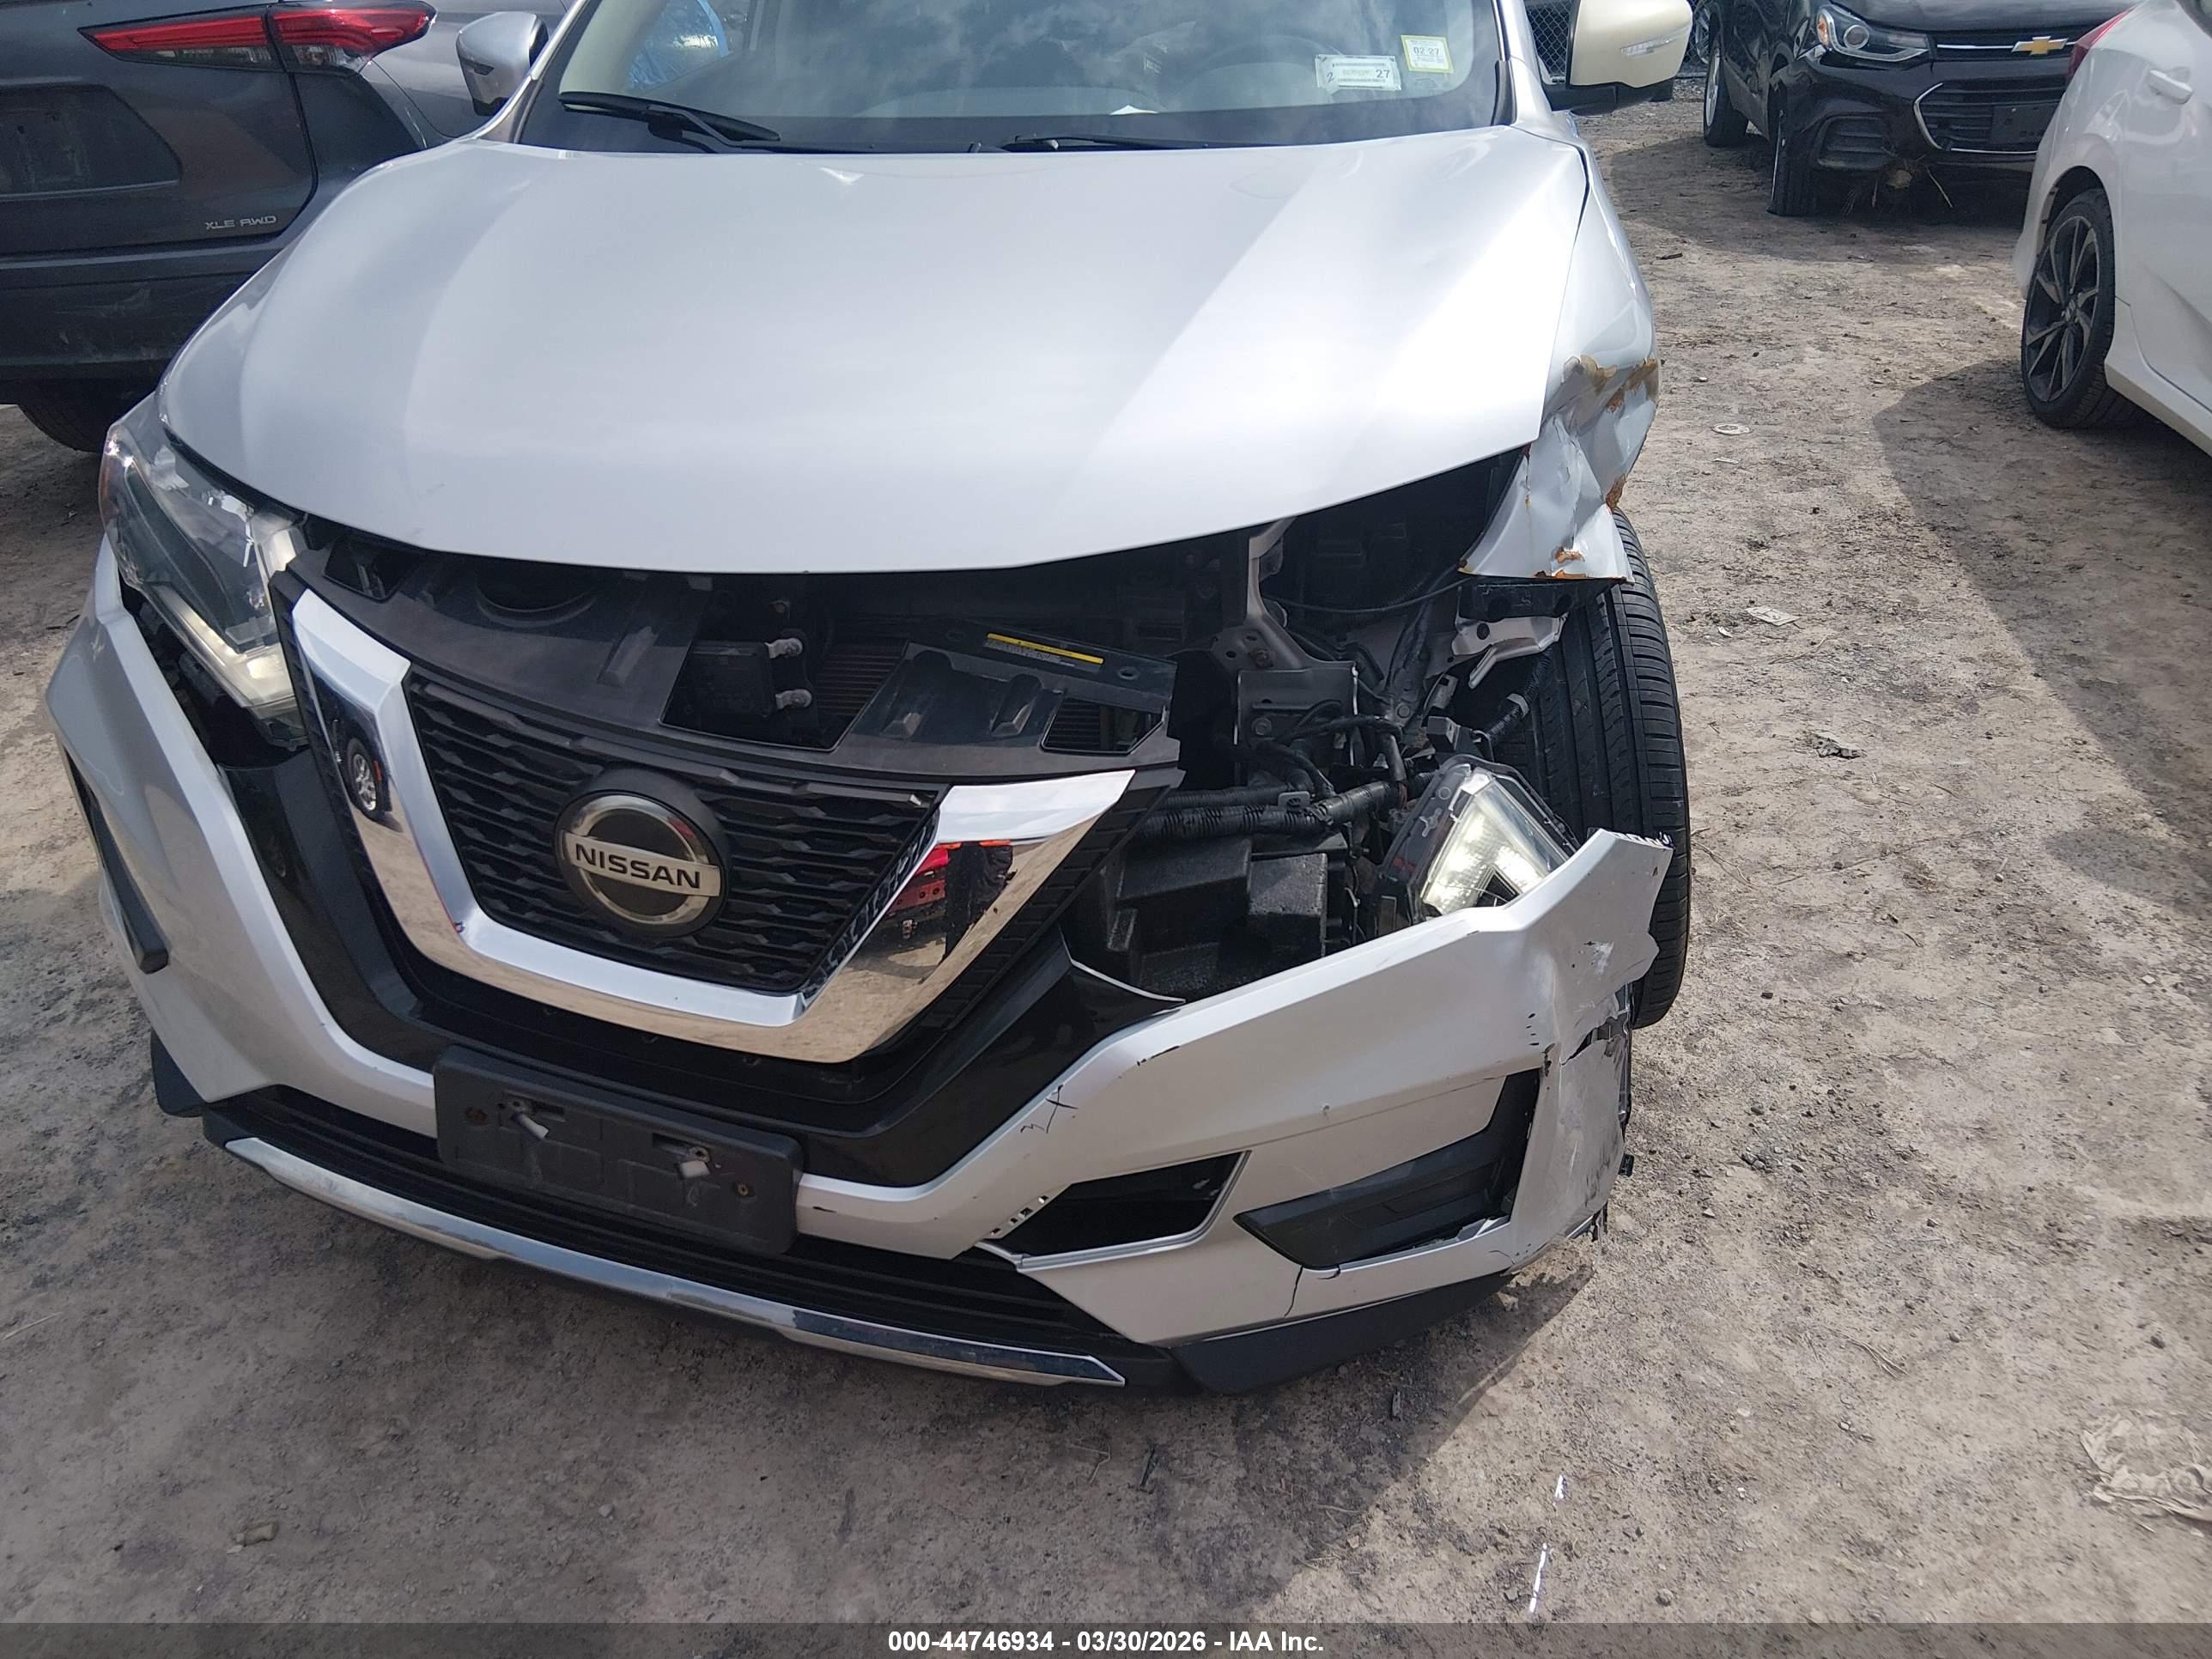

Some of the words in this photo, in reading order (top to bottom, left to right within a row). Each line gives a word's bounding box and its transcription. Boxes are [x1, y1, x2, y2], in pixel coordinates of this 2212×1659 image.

[1376, 69, 1390, 79] 27
[204, 219, 235, 230] XLE
[240, 215, 276, 227] AWD
[574, 842, 701, 890] NISSAN
